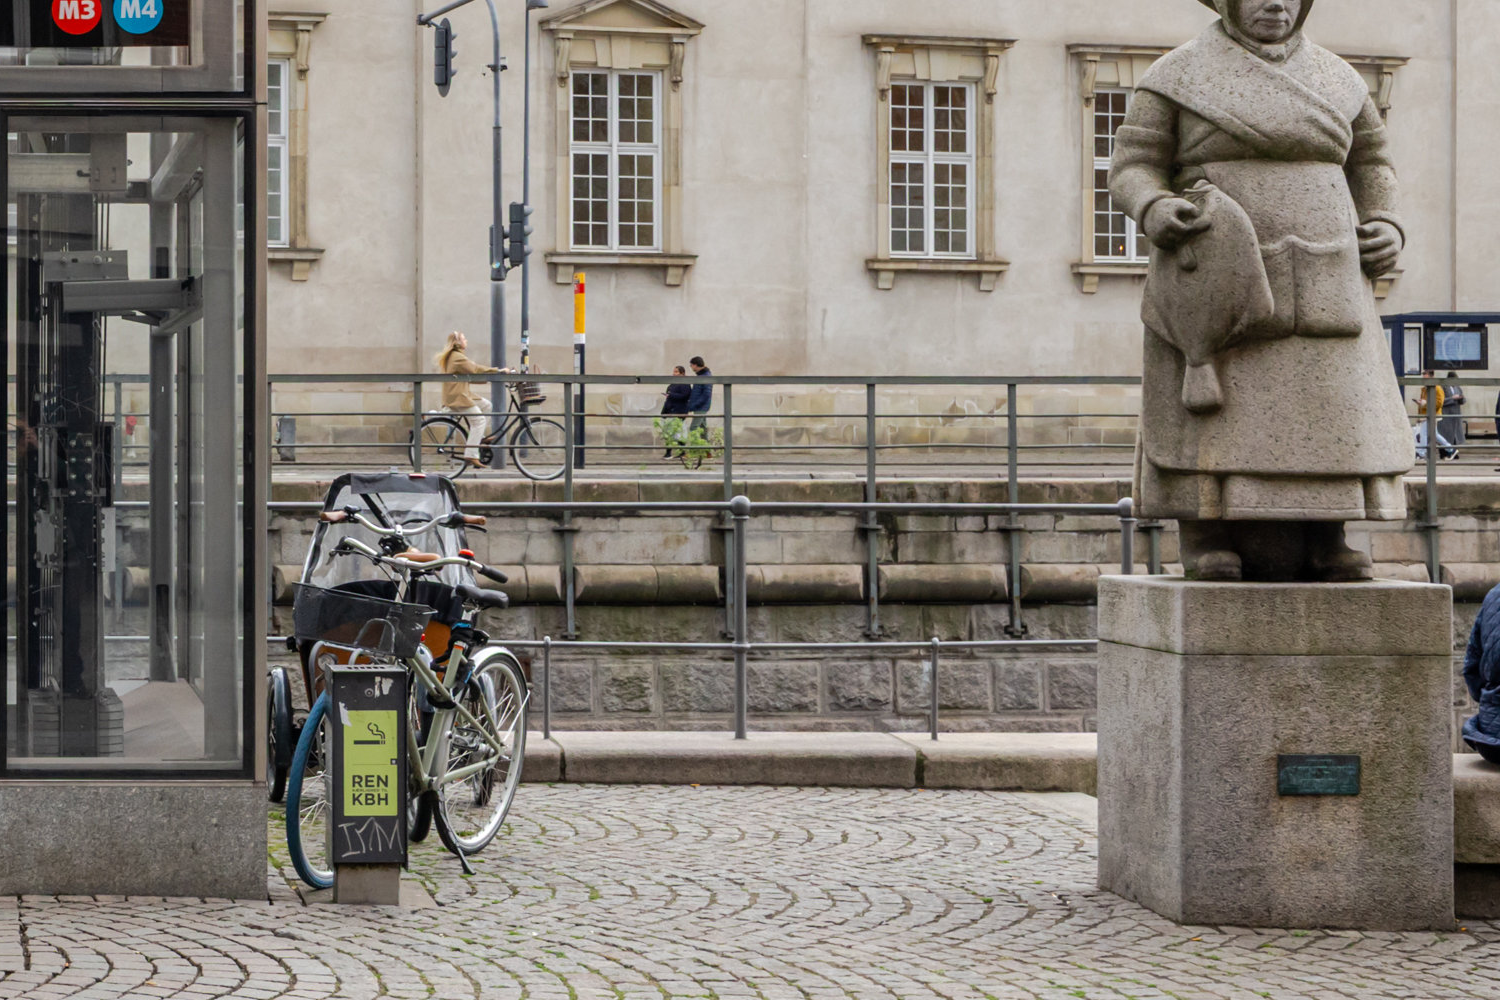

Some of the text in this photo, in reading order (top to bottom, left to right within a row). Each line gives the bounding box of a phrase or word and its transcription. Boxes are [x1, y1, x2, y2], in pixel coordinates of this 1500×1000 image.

[58, 0, 96, 20] M3
[352, 774, 389, 788] REN
[352, 793, 389, 806] KBH
